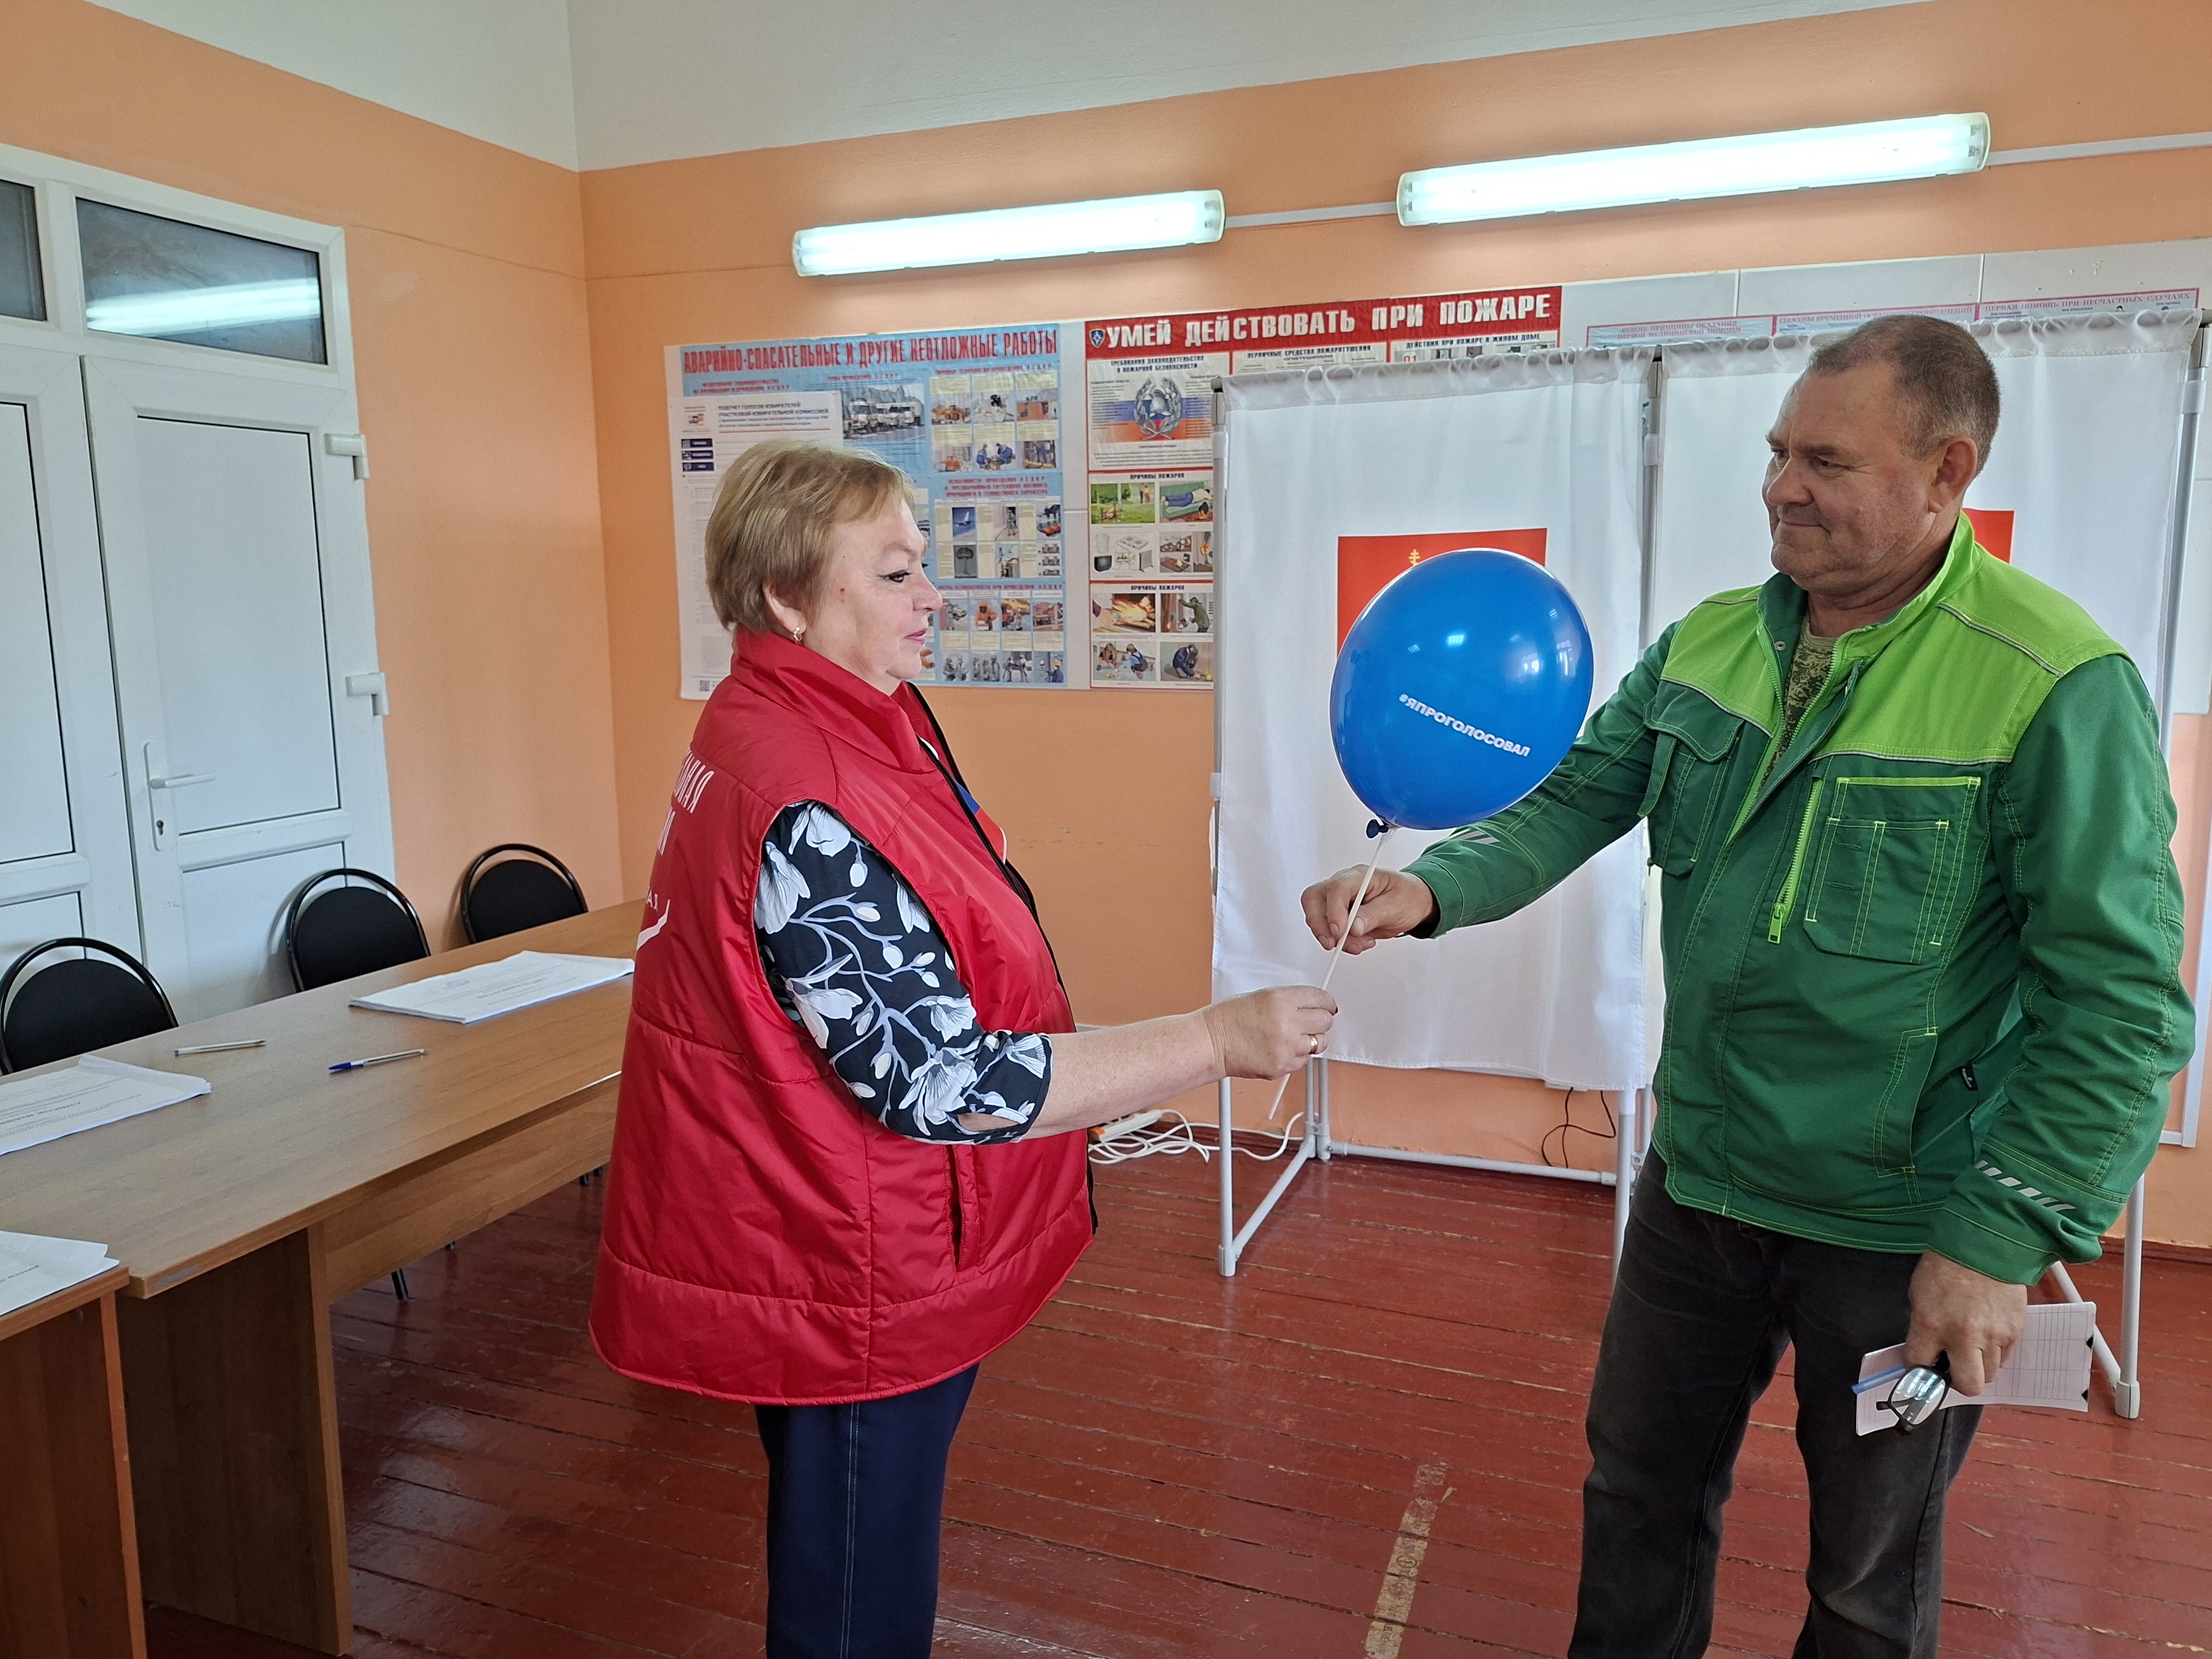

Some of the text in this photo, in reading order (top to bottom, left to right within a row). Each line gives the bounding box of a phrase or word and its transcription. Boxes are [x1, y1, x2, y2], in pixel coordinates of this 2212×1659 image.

[2022, 301, 2058, 310] ПОМОЩЬ
[2083, 295, 2142, 306] НЕСЧАСТНЫХ
[2147, 292, 2190, 302] СЛУЧАЯХ
[1107, 294, 1551, 348] УМЕЙ ДЕЙСТВОВАТЬ ПРИ ПОЖАРЕ
[685, 330, 1057, 374] АВАРИЙНО-СПАСАТЕЛЬНЫЕ И ДРУГИЕ НЕОТЛОЖНЫЕ РАБОТЫ
[1317, 345, 1371, 354] ПОЖАРОТУШЕНИЯ
[1406, 340, 1438, 349] ДЕЙСТВИЯ
[1399, 693, 1531, 757] #ЯПРОГОЛОСОВАЛ
